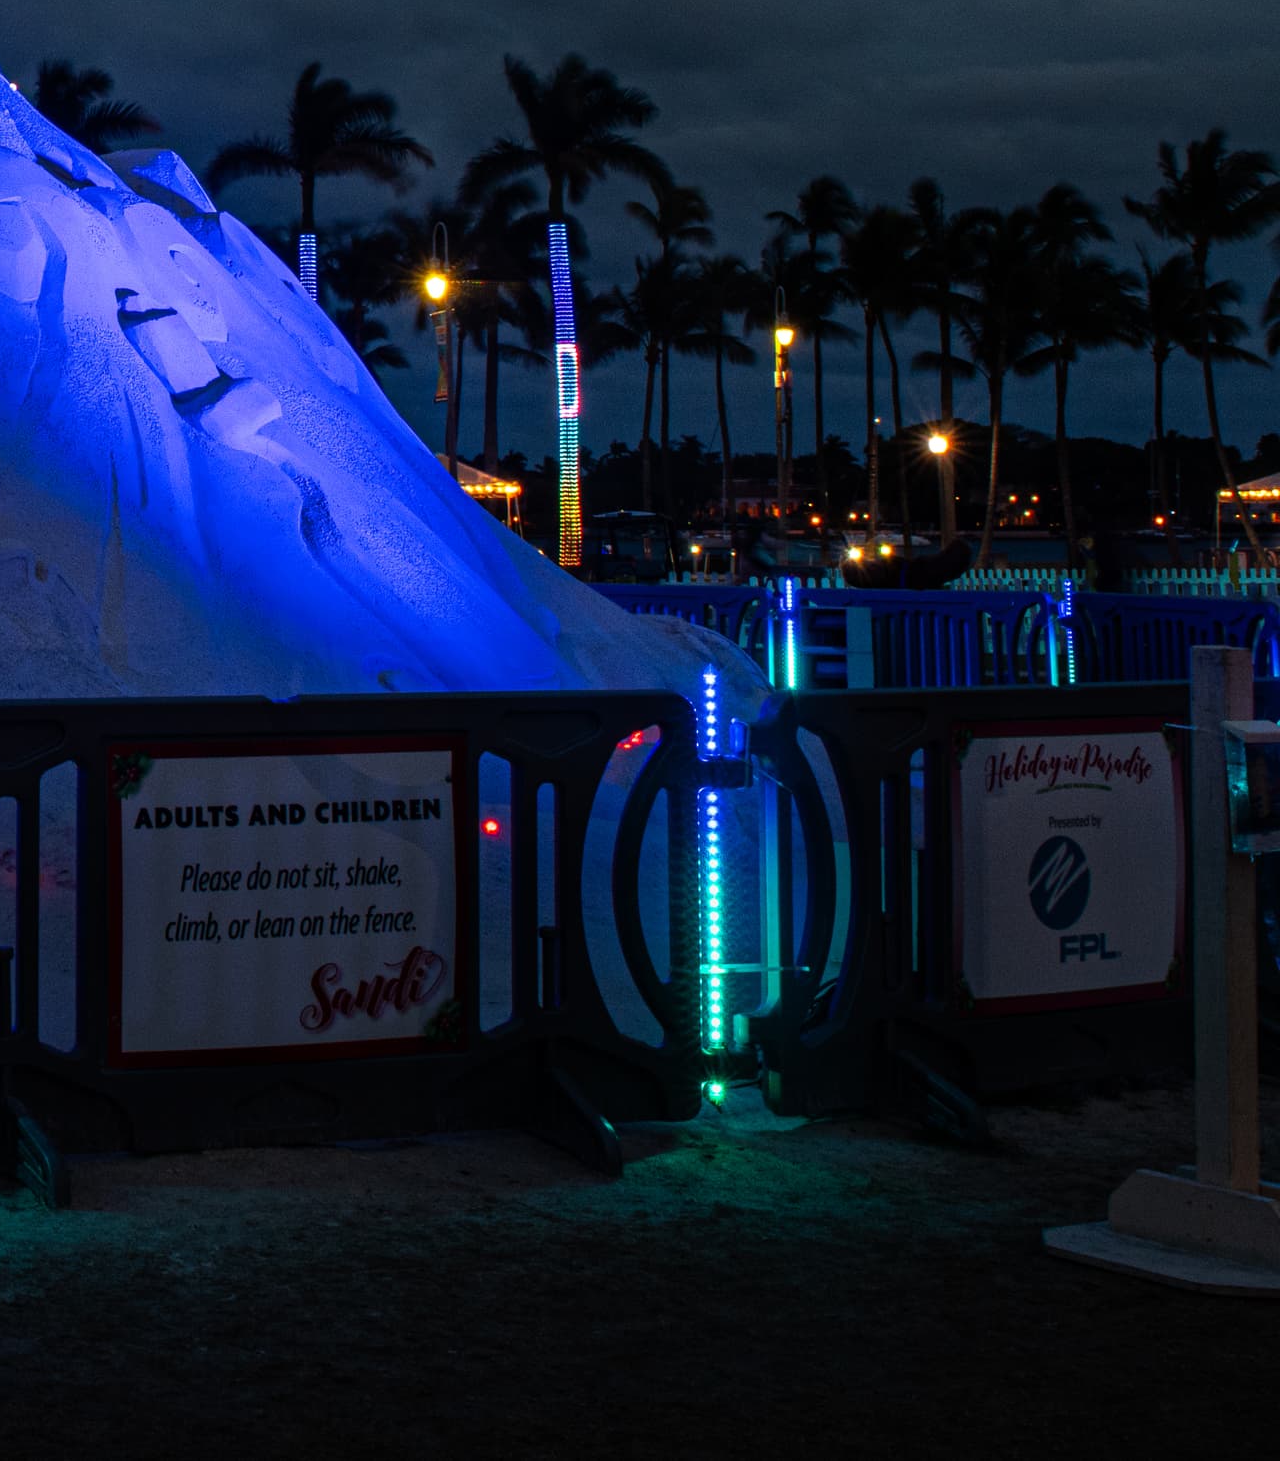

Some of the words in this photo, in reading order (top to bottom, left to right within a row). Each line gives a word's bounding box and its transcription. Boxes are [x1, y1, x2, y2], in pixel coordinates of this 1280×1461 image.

[984, 744, 1061, 792] Holiday
[1063, 755, 1079, 774] in
[1079, 743, 1152, 784] Paradise
[134, 805, 239, 830] ADULTS
[248, 803, 306, 826] AND
[315, 798, 441, 824] CHILDREN
[1048, 816, 1089, 828] Presented
[1091, 815, 1102, 828] by
[180, 864, 242, 892] Please
[246, 861, 271, 890] do
[276, 864, 309, 889] not
[313, 861, 340, 890] sit,
[344, 857, 402, 887] shake,
[165, 912, 222, 943] climb,
[228, 918, 249, 939] or
[254, 910, 294, 938] lean
[300, 916, 324, 936] on
[329, 906, 360, 935] the
[364, 905, 416, 934] fence.
[1060, 933, 1119, 963] FPL
[300, 946, 447, 1031] Sandi
